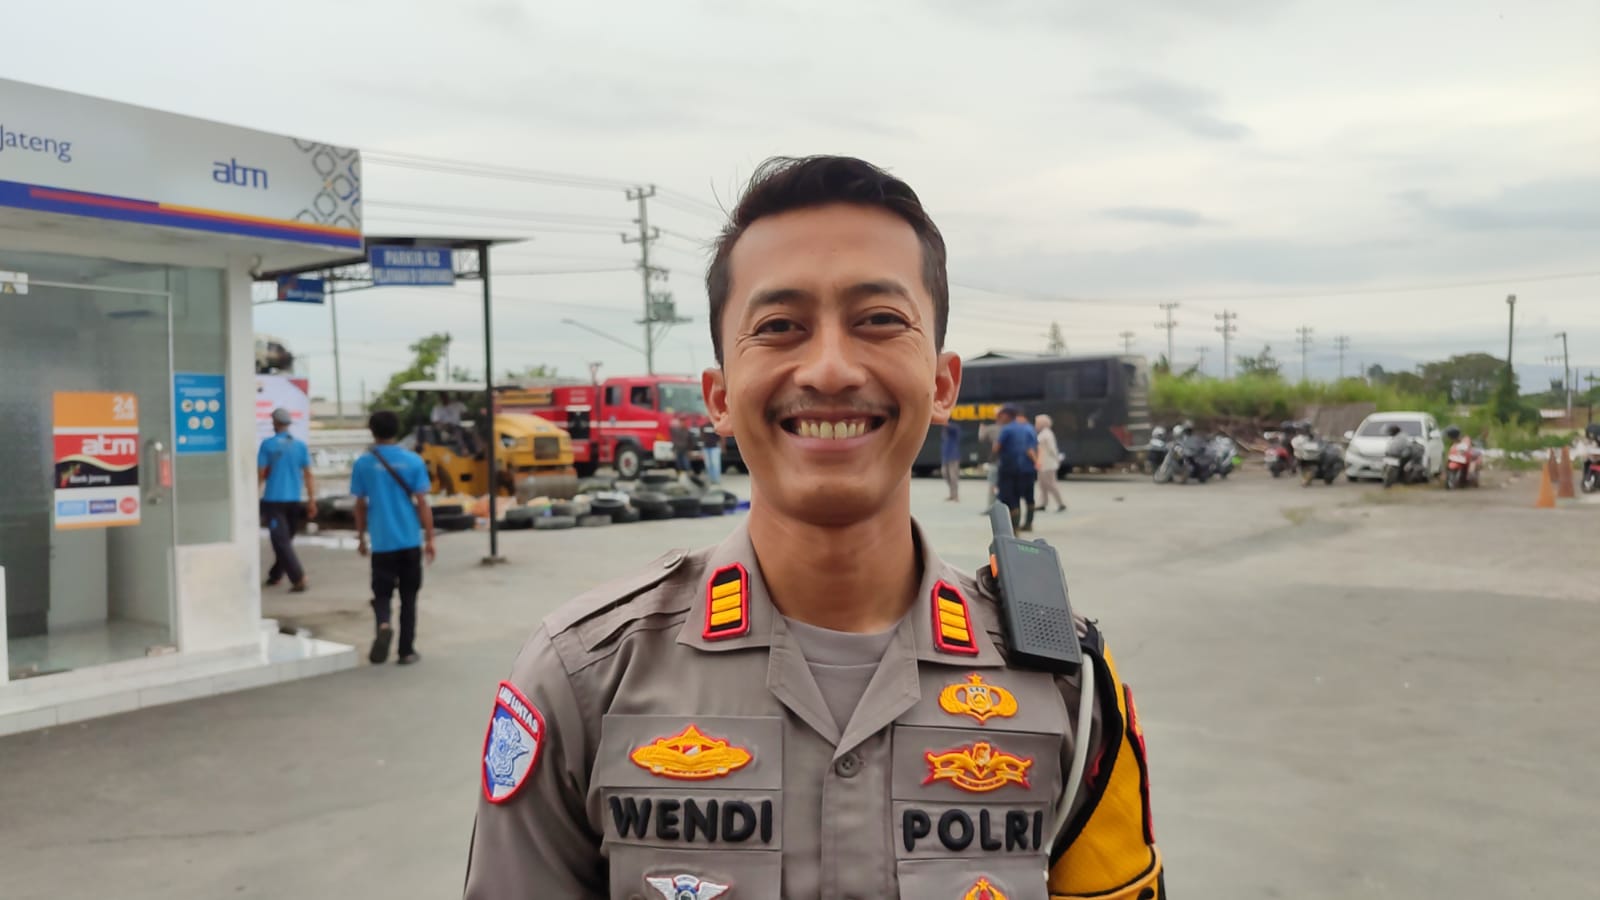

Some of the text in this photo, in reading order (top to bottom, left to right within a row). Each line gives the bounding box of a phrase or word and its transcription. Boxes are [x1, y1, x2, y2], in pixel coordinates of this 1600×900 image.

[0, 124, 72, 163] Jateng
[213, 157, 268, 189] atm
[113, 396, 134, 413] 24
[82, 434, 136, 456] atm
[608, 796, 773, 843] WENDI
[902, 808, 1042, 852] POLRI
